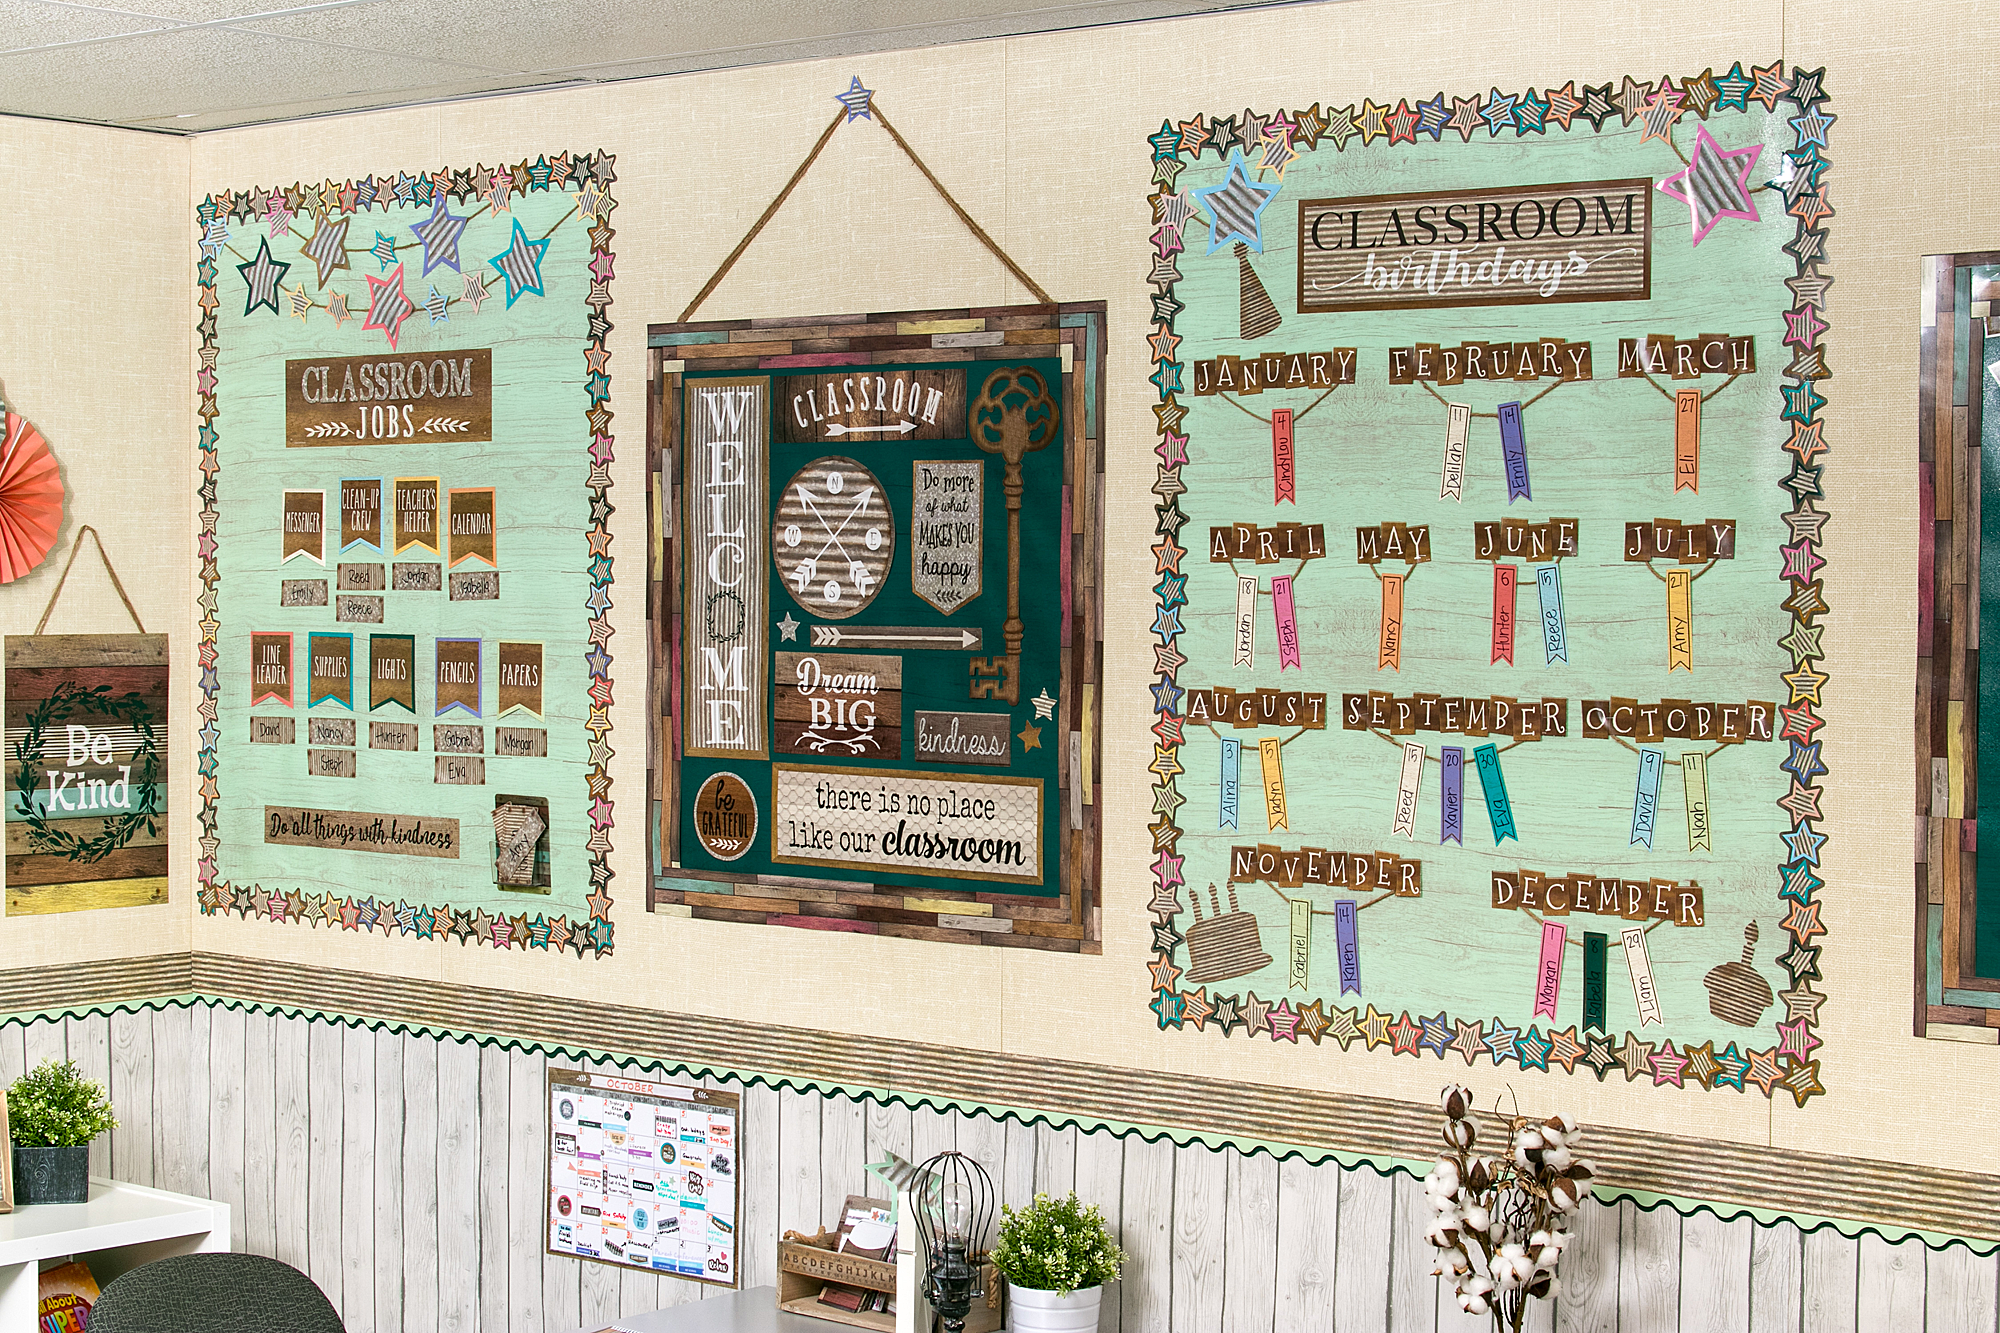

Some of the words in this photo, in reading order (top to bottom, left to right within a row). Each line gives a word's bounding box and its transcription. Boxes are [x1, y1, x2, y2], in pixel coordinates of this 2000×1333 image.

[1310, 193, 1638, 252] CLASSROOM
[1312, 244, 1638, 298] birthdays
[1392, 342, 1588, 381] FEBRUARY
[1619, 340, 1749, 376] MARCH
[301, 357, 473, 405] CLASSROOM
[1198, 350, 1354, 392] JANUARY
[793, 375, 944, 428] CLASSROOM
[1680, 398, 1695, 413] 27
[355, 404, 415, 440] JOBS
[1278, 415, 1286, 430] 4
[1454, 408, 1462, 422] 11
[1504, 408, 1515, 424] 14
[1447, 442, 1462, 488] Delilah
[1508, 450, 1526, 489] Emily
[1679, 454, 1695, 474] Eli
[830, 477, 840, 490] N
[922, 468, 939, 491] Do
[944, 470, 975, 493] more
[342, 488, 380, 510] CLEAN-UP
[397, 488, 437, 511] TEACHER'S
[925, 498, 939, 517] of
[940, 498, 969, 514] what
[286, 512, 320, 533] MESSENGER
[351, 510, 371, 532] CREW
[404, 511, 431, 533] HELPER
[452, 513, 492, 535] CALENDAR
[788, 530, 799, 543] W
[869, 533, 879, 546] E
[919, 521, 953, 548] MAKES
[954, 522, 975, 545] YOU
[1211, 527, 1321, 560] APRIL
[1358, 526, 1426, 560] MAY
[1480, 522, 1574, 558] JUNE
[1628, 524, 1731, 558] JULY
[401, 570, 430, 584] Jordan
[921, 552, 972, 586] happy
[1501, 571, 1509, 586] 6
[1540, 571, 1551, 586] 15
[1670, 574, 1682, 588] 21
[292, 585, 315, 602] Emily
[460, 579, 490, 594] Isabella
[828, 584, 837, 598] S
[1241, 580, 1252, 595] 18
[1276, 582, 1286, 595] 21
[1388, 581, 1396, 595] 7
[347, 600, 373, 615] Reece
[1238, 614, 1251, 658] Jordan
[1280, 619, 1296, 656] Steph
[1383, 617, 1400, 657] Nancy
[1496, 605, 1511, 652] Hunter
[1548, 608, 1564, 652] Reece
[1672, 617, 1689, 653] Amy
[263, 644, 281, 665] LINE
[256, 664, 287, 685] LEADER
[314, 656, 347, 678] SUPPLIES
[377, 658, 406, 680] LIGHTS
[440, 661, 475, 684] PENCILS
[502, 663, 539, 687] PAPERS
[794, 657, 880, 696] Dream
[808, 697, 878, 733] BIG
[1188, 692, 1323, 723] AUGUST
[1348, 696, 1565, 737] SEPTEMBER
[260, 722, 280, 738] David
[317, 724, 344, 740] Nancy
[1586, 705, 1771, 739] OCTOBER
[66, 724, 114, 768] Be
[376, 726, 407, 744] Hunter
[444, 729, 473, 748] Gabriel
[504, 734, 534, 755] Morgan
[918, 717, 1006, 757] kindness
[1225, 743, 1234, 759] 3
[1265, 742, 1274, 759] 5
[1408, 748, 1418, 763] 15
[1446, 754, 1459, 767] 20
[1480, 754, 1495, 769] 30
[320, 754, 344, 774] Steph
[448, 762, 466, 780] Eva
[1645, 754, 1655, 772] 9
[1687, 757, 1696, 771] 11
[46, 765, 132, 812] Kind
[715, 779, 735, 811] be
[1223, 780, 1237, 815] Alina
[816, 781, 872, 813] there
[878, 786, 901, 815] is
[906, 796, 931, 816] no
[937, 790, 996, 825] place
[1269, 781, 1285, 826] Jadyn
[1398, 790, 1414, 824] Reed
[1444, 787, 1458, 829] Xavier
[1496, 799, 1510, 828] Eva
[1635, 792, 1654, 832] David
[269, 812, 290, 838] Do
[292, 811, 312, 837] all
[313, 813, 356, 846] things
[358, 817, 387, 845] with
[389, 819, 453, 850] kindness
[702, 810, 749, 839] GRATEFUL
[1690, 801, 1706, 839] Noah
[508, 833, 531, 862] Amy
[788, 821, 834, 850] like
[839, 830, 875, 854] our
[882, 820, 1026, 867] classroom
[1234, 850, 1420, 895] NOVEMBER
[1494, 876, 1703, 926] DECEMBER
[1339, 906, 1350, 924] 14
[1591, 940, 1599, 954] 8
[1627, 934, 1641, 949] 29
[1292, 934, 1307, 979] Gabriel
[1343, 943, 1357, 982] Karen
[1540, 961, 1557, 1007] Morgan
[1587, 970, 1601, 1018] Isabella
[1638, 976, 1654, 1013] Liam
[607, 1079, 653, 1094] OCTOBER
[46, 1292, 78, 1311] About
